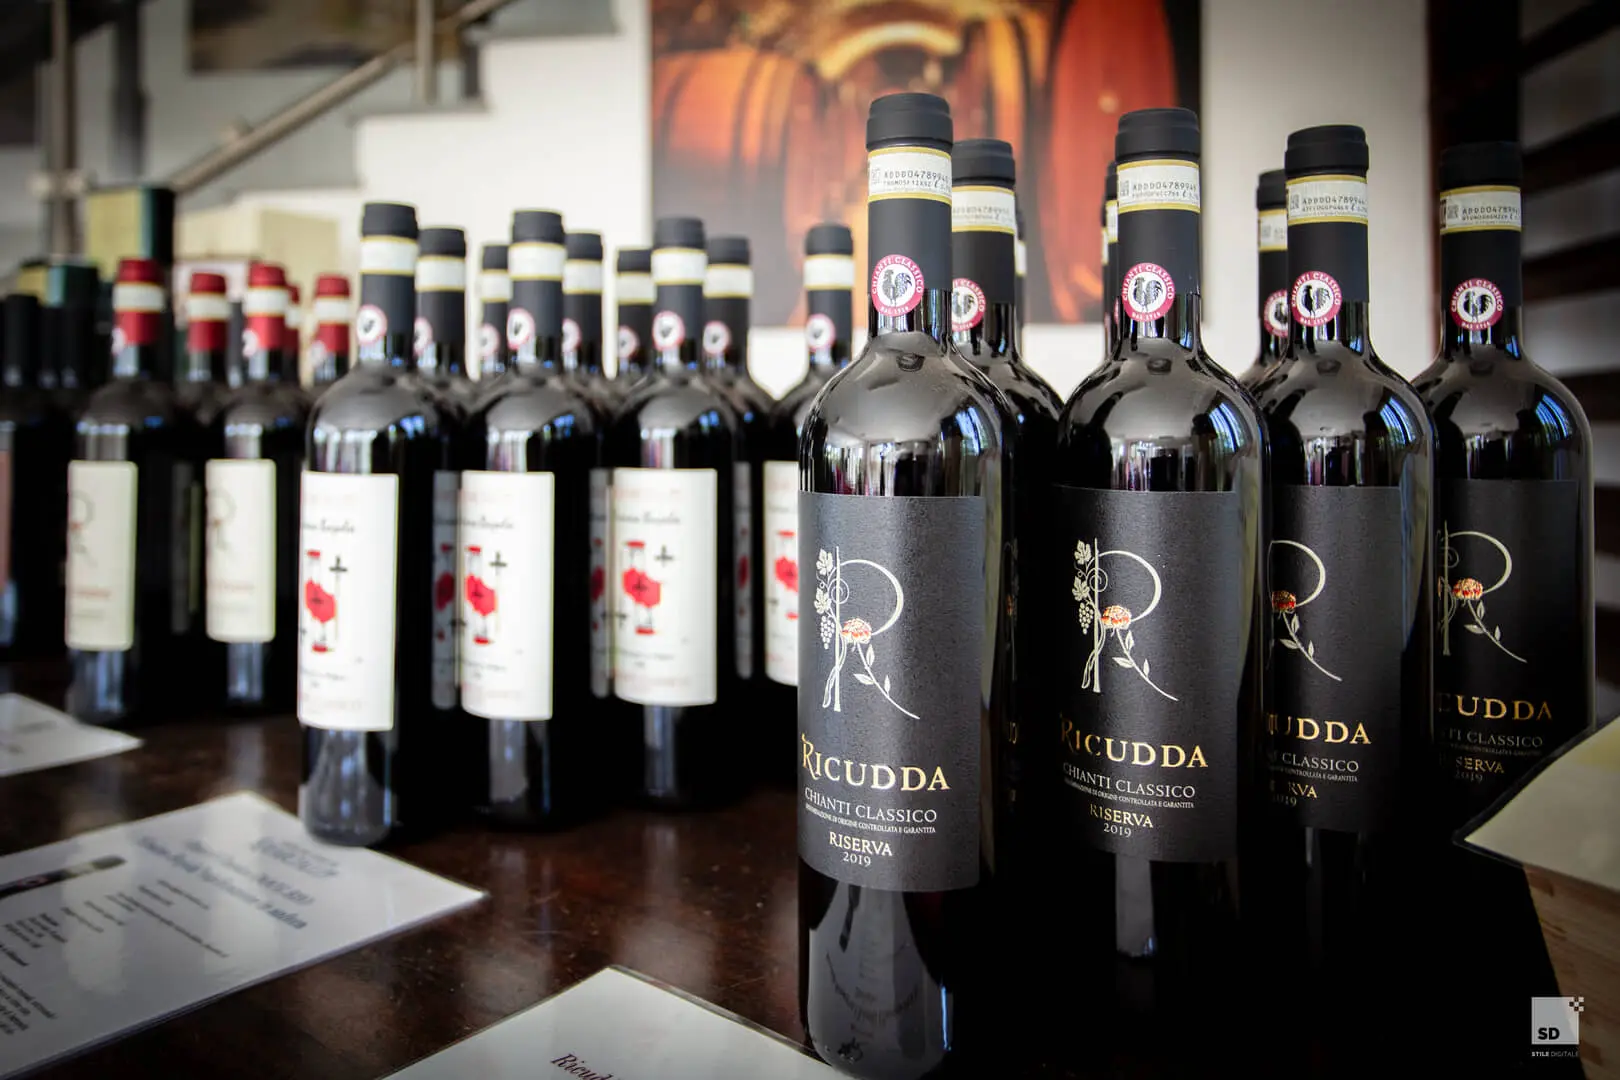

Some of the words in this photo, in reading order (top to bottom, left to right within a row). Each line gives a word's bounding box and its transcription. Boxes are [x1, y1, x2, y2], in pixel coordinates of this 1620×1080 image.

[871, 257, 892, 295] CHIANTI
[895, 256, 923, 293] CLASSICO
[1122, 265, 1142, 301] CHIANTI
[1146, 265, 1174, 300] CLASSICO
[1291, 273, 1310, 307] CHIANTI
[1313, 272, 1341, 305] CLASSICO
[1451, 280, 1473, 312] CHIANTI
[1476, 279, 1503, 312] CLASSICO
[1060, 711, 1209, 768] RICUDDA
[1467, 730, 1544, 749] CLASSICO
[801, 732, 952, 791] RICUDDA
[1282, 751, 1360, 773] CLASSICO
[1062, 761, 1111, 790] CHIANTI
[1115, 778, 1196, 799] CLASSICO
[805, 787, 850, 815] CHIANTI
[855, 804, 938, 823] CLASSICO
[1089, 802, 1154, 828] RISERVA
[1119, 795, 1158, 807] CONTROLLATA
[1163, 800, 1195, 809] GARANTITA
[858, 822, 898, 833] CONTROLLATA
[903, 826, 936, 834] GARANTITA
[1103, 822, 1132, 838] 2019
[829, 831, 893, 856] RISERVA
[843, 851, 872, 867] 2019
